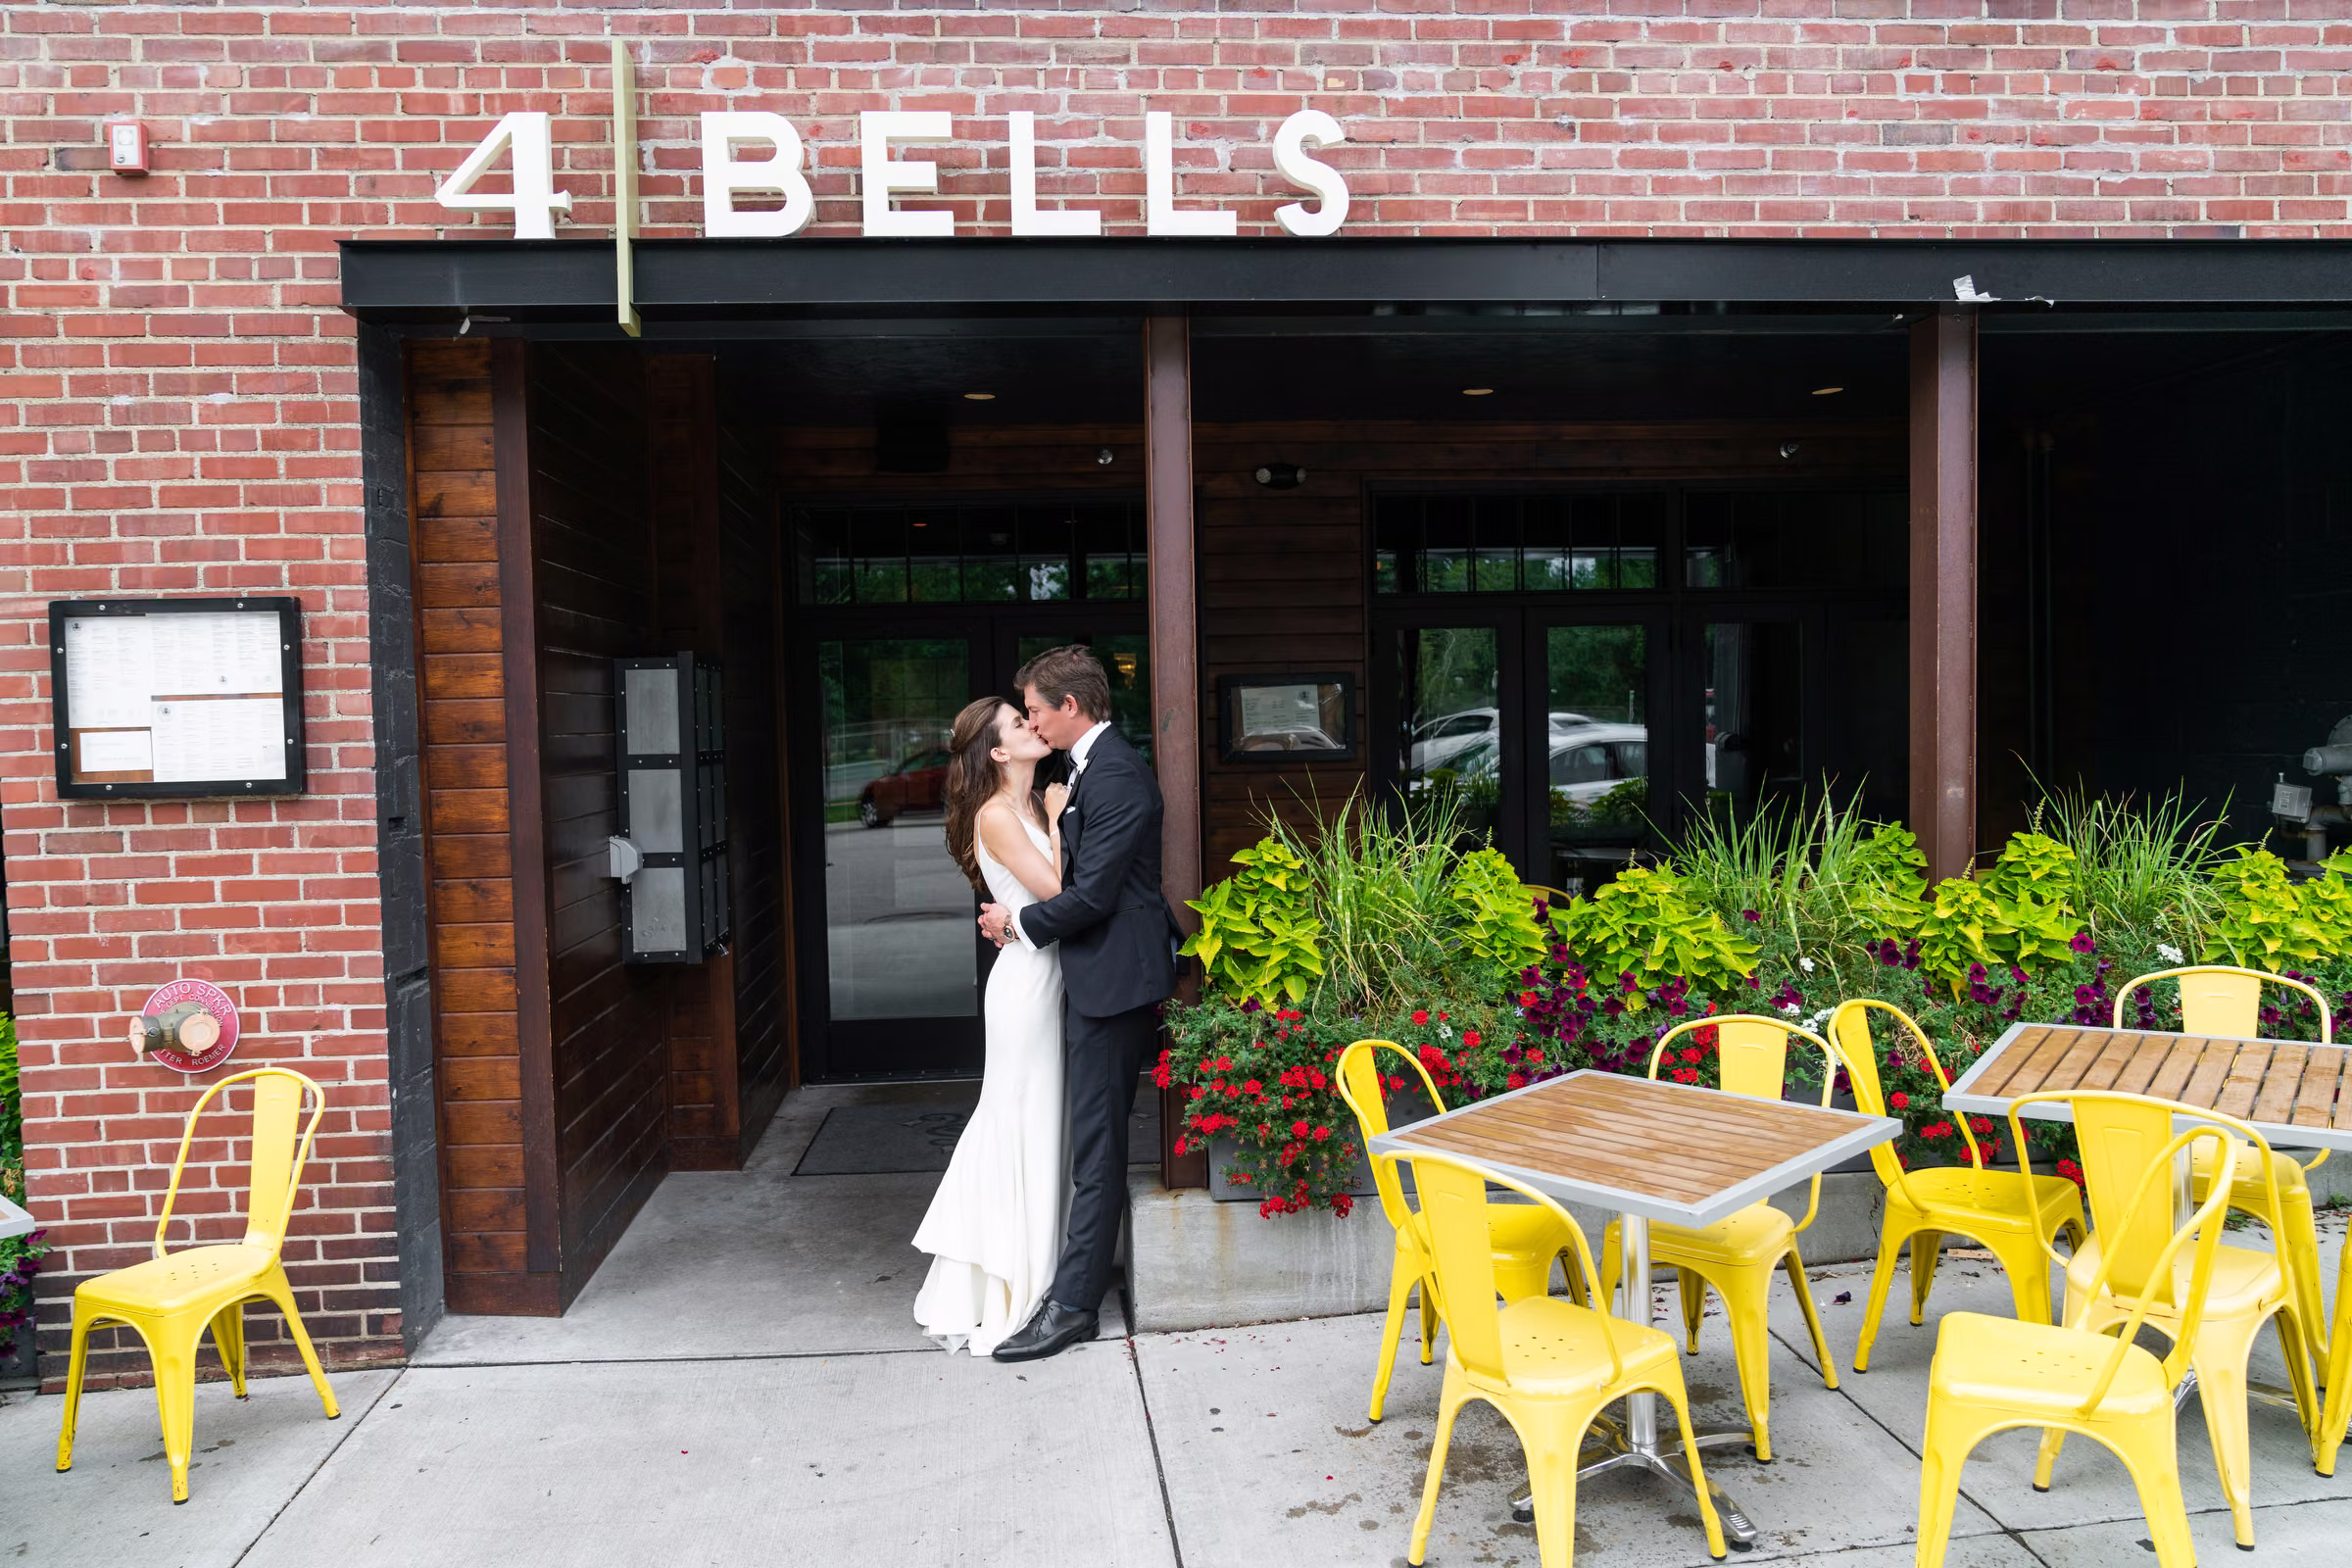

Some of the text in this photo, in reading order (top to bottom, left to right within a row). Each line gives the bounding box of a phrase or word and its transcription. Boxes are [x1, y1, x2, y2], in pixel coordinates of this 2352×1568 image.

[434, 109, 1350, 240] 4 BELLS
[154, 983, 232, 1016] AUTO SPKR
[166, 994, 184, 1008] DEPT
[160, 1044, 226, 1066] TTER ROEMER
